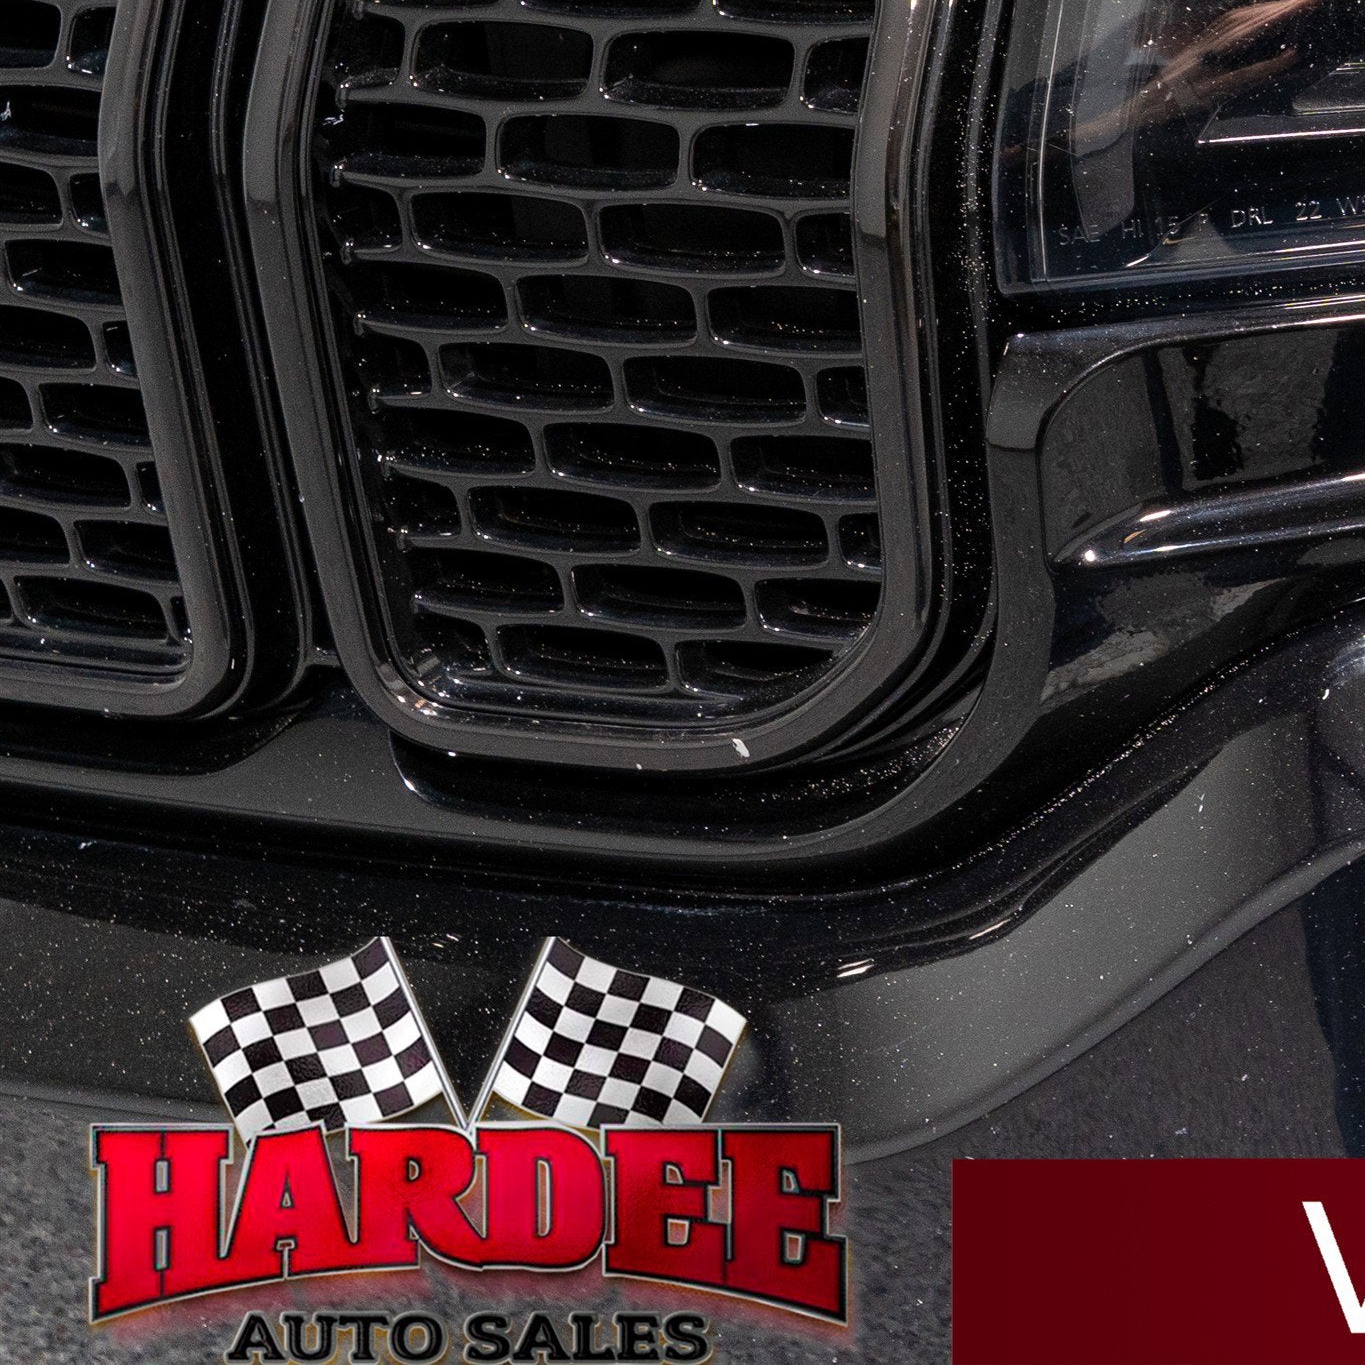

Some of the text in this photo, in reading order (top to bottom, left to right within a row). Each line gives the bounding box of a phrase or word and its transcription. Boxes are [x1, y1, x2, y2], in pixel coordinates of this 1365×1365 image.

[1057, 223, 1101, 246] SAE
[1230, 205, 1274, 229] DRL
[1294, 200, 1323, 221] 22
